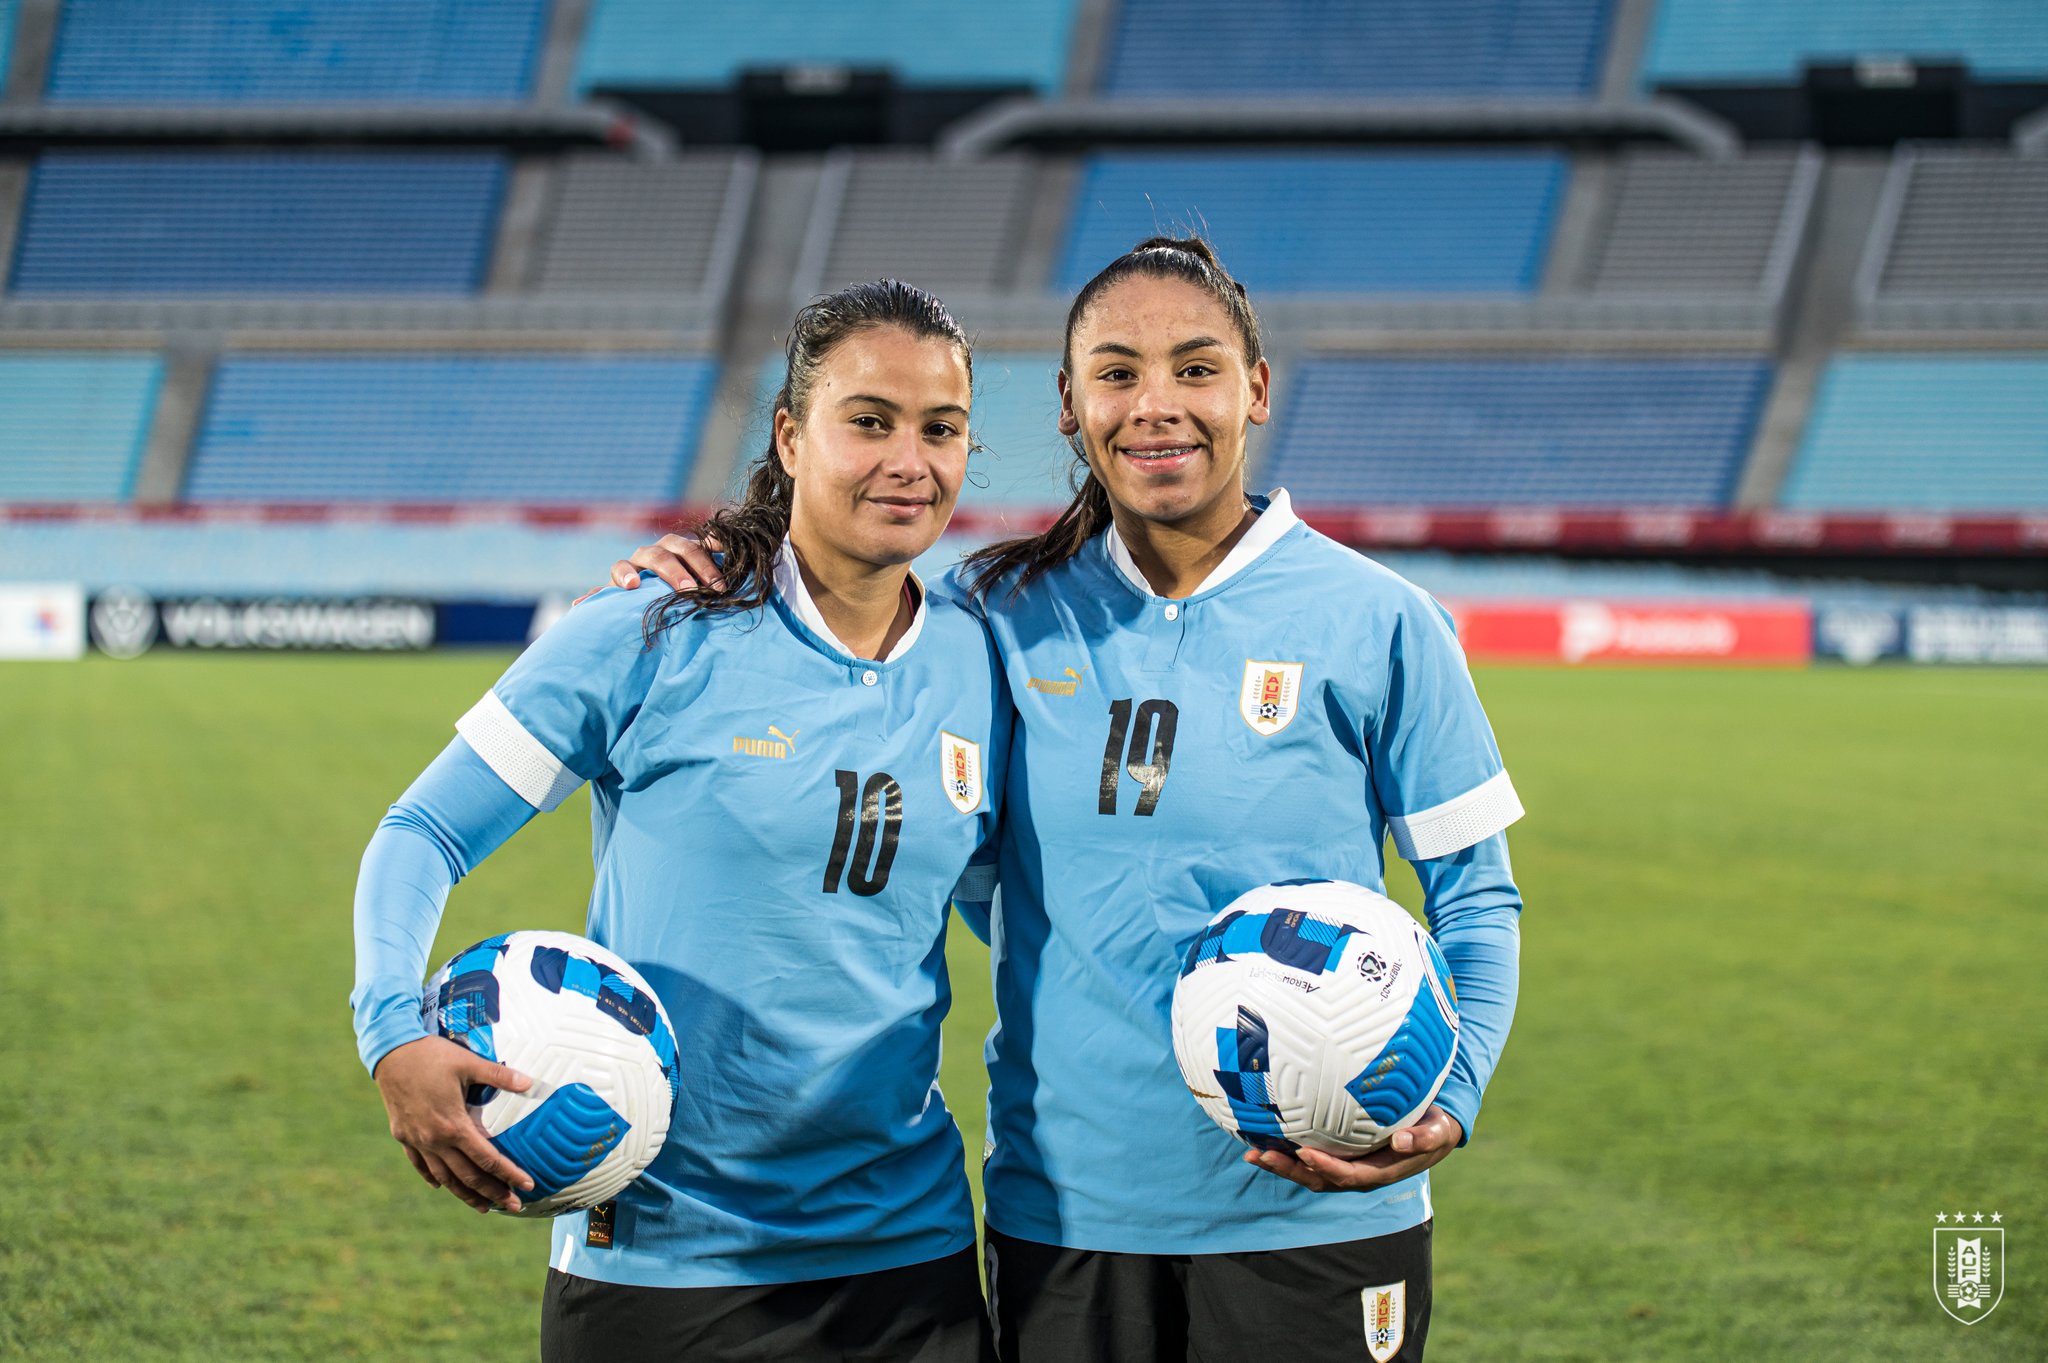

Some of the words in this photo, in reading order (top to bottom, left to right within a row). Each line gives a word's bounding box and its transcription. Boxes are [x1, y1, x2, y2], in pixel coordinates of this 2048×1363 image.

[1026, 677, 1077, 696] PUMA
[733, 736, 786, 760] PUMA
[1098, 698, 1179, 816] 19
[822, 769, 903, 897] 10
